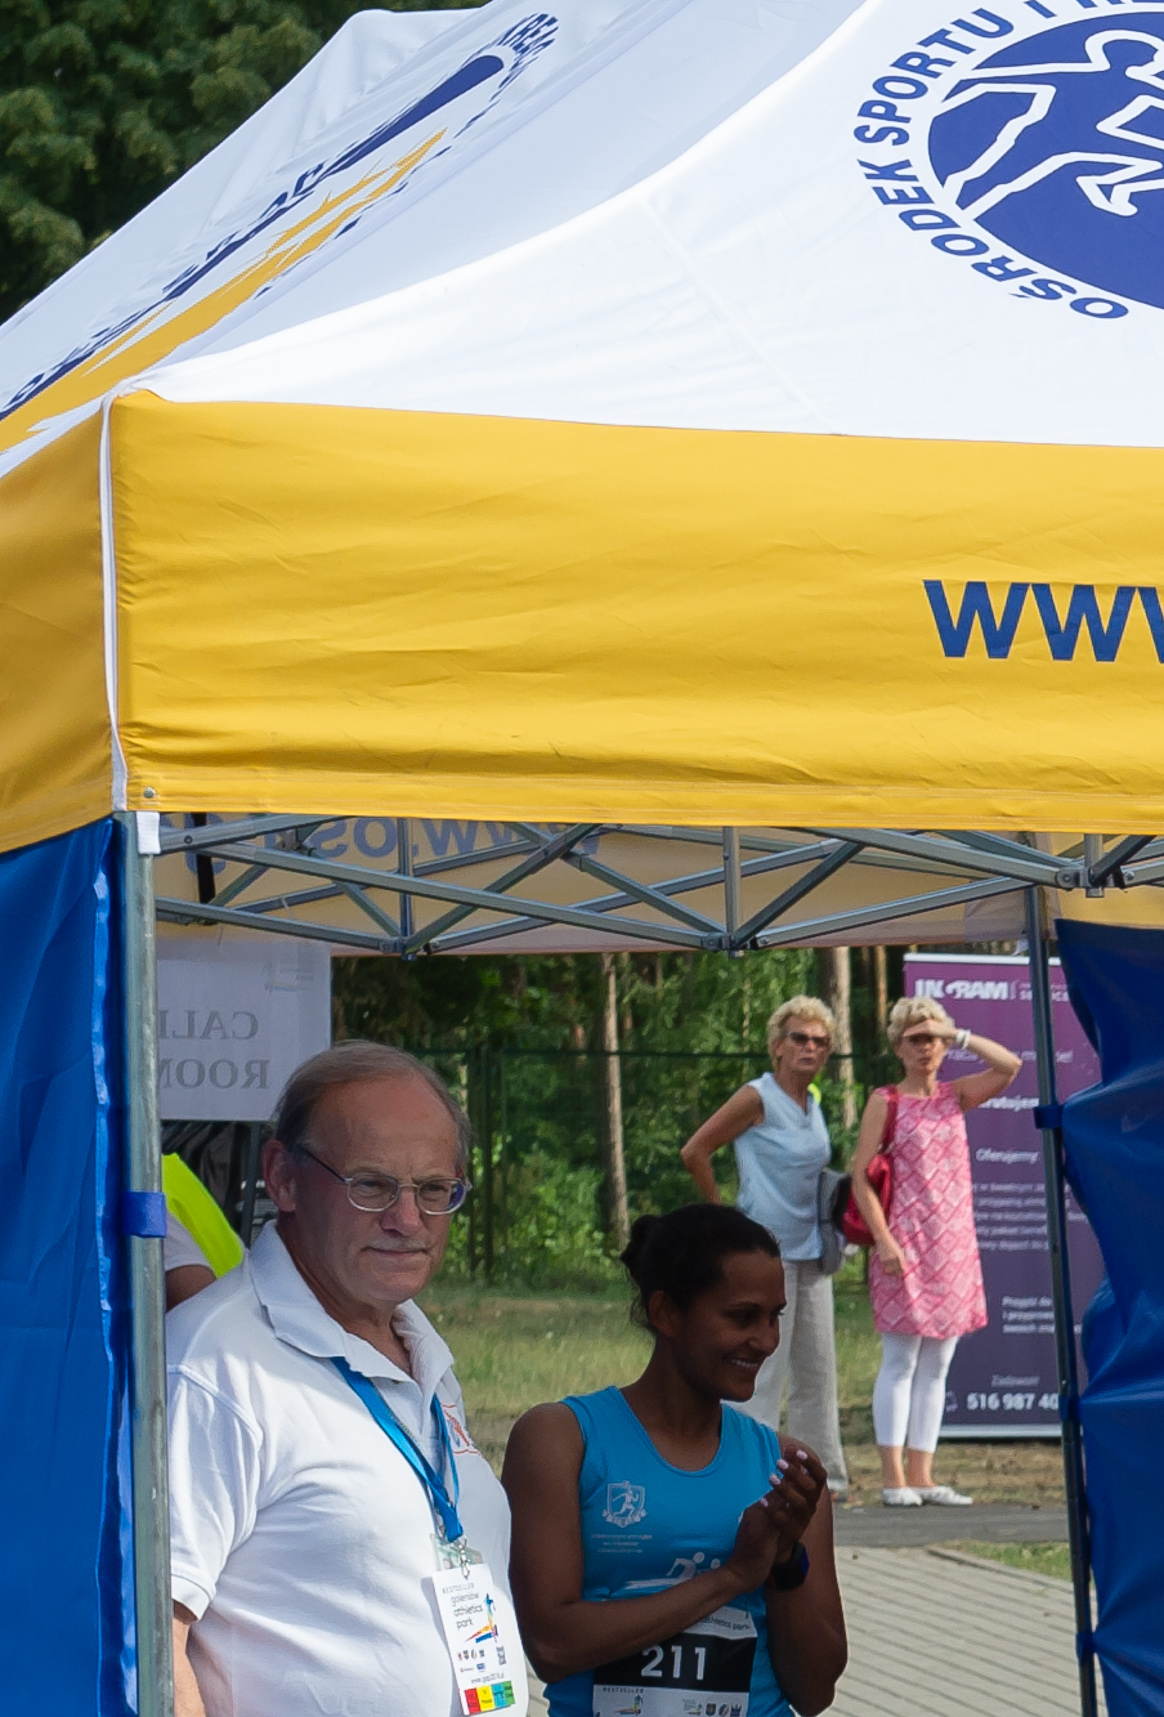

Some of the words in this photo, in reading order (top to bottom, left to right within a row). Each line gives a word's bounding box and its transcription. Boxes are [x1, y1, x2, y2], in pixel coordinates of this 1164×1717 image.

[853, 8, 1014, 146] SPORTU
[856, 158, 1129, 319] OŚRODEK
[966, 1392, 999, 1411] 516
[1002, 1392, 1036, 1411] 987
[1038, 1392, 1060, 1410] 40
[640, 1645, 707, 1681] 211
